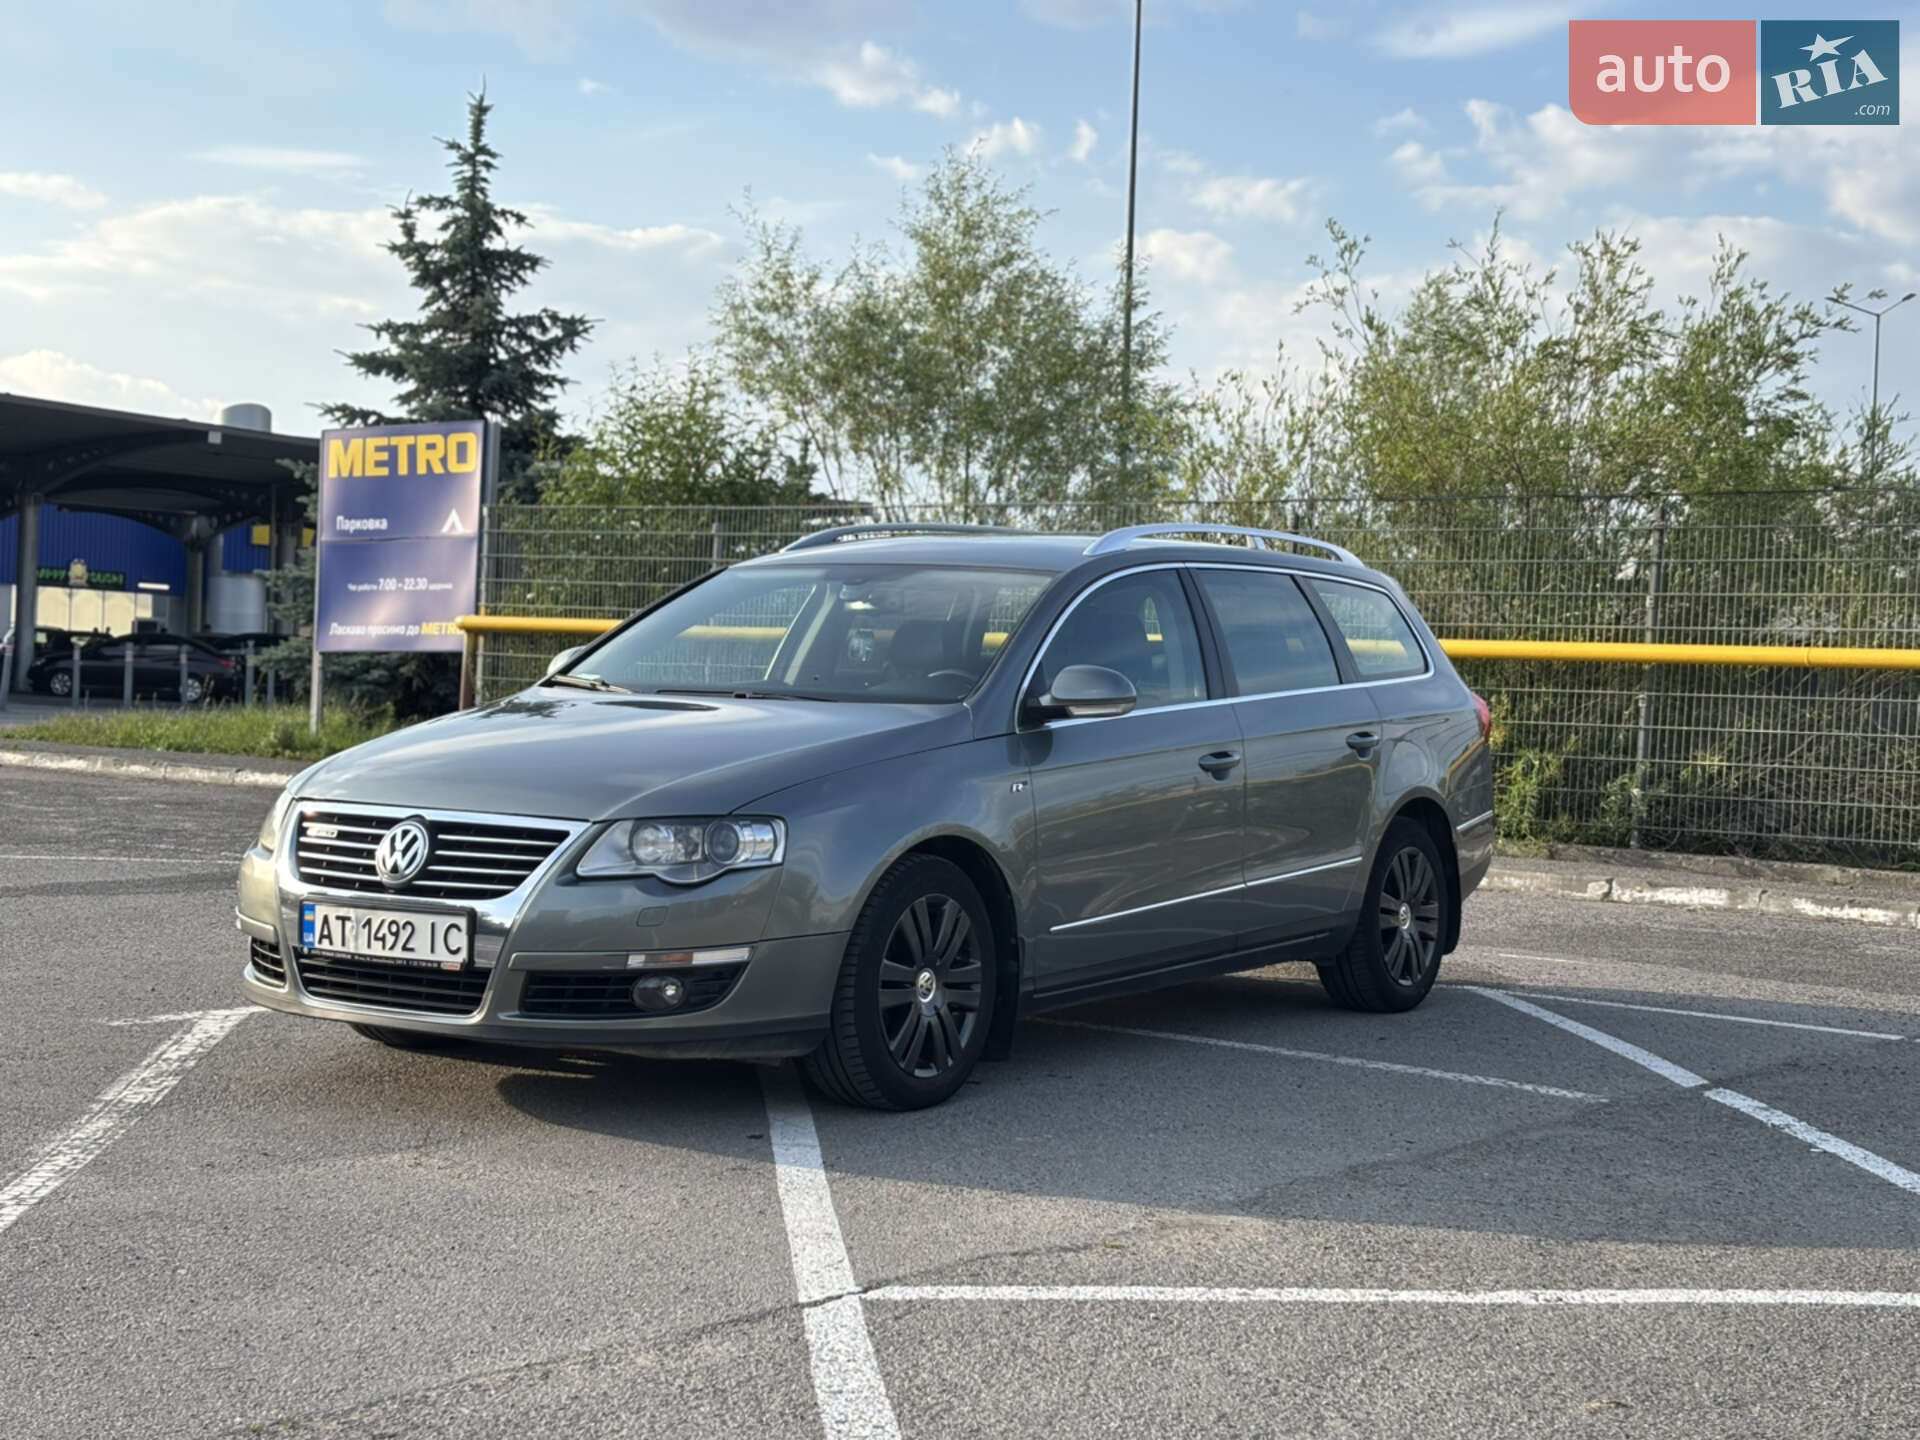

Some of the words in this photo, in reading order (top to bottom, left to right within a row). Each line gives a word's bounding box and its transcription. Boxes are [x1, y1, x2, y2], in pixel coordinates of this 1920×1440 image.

[327, 432, 478, 478] METRO
[336, 515, 388, 533] Парковка
[318, 914, 353, 947] AT
[361, 917, 416, 952] 1492
[430, 921, 463, 955] IC
